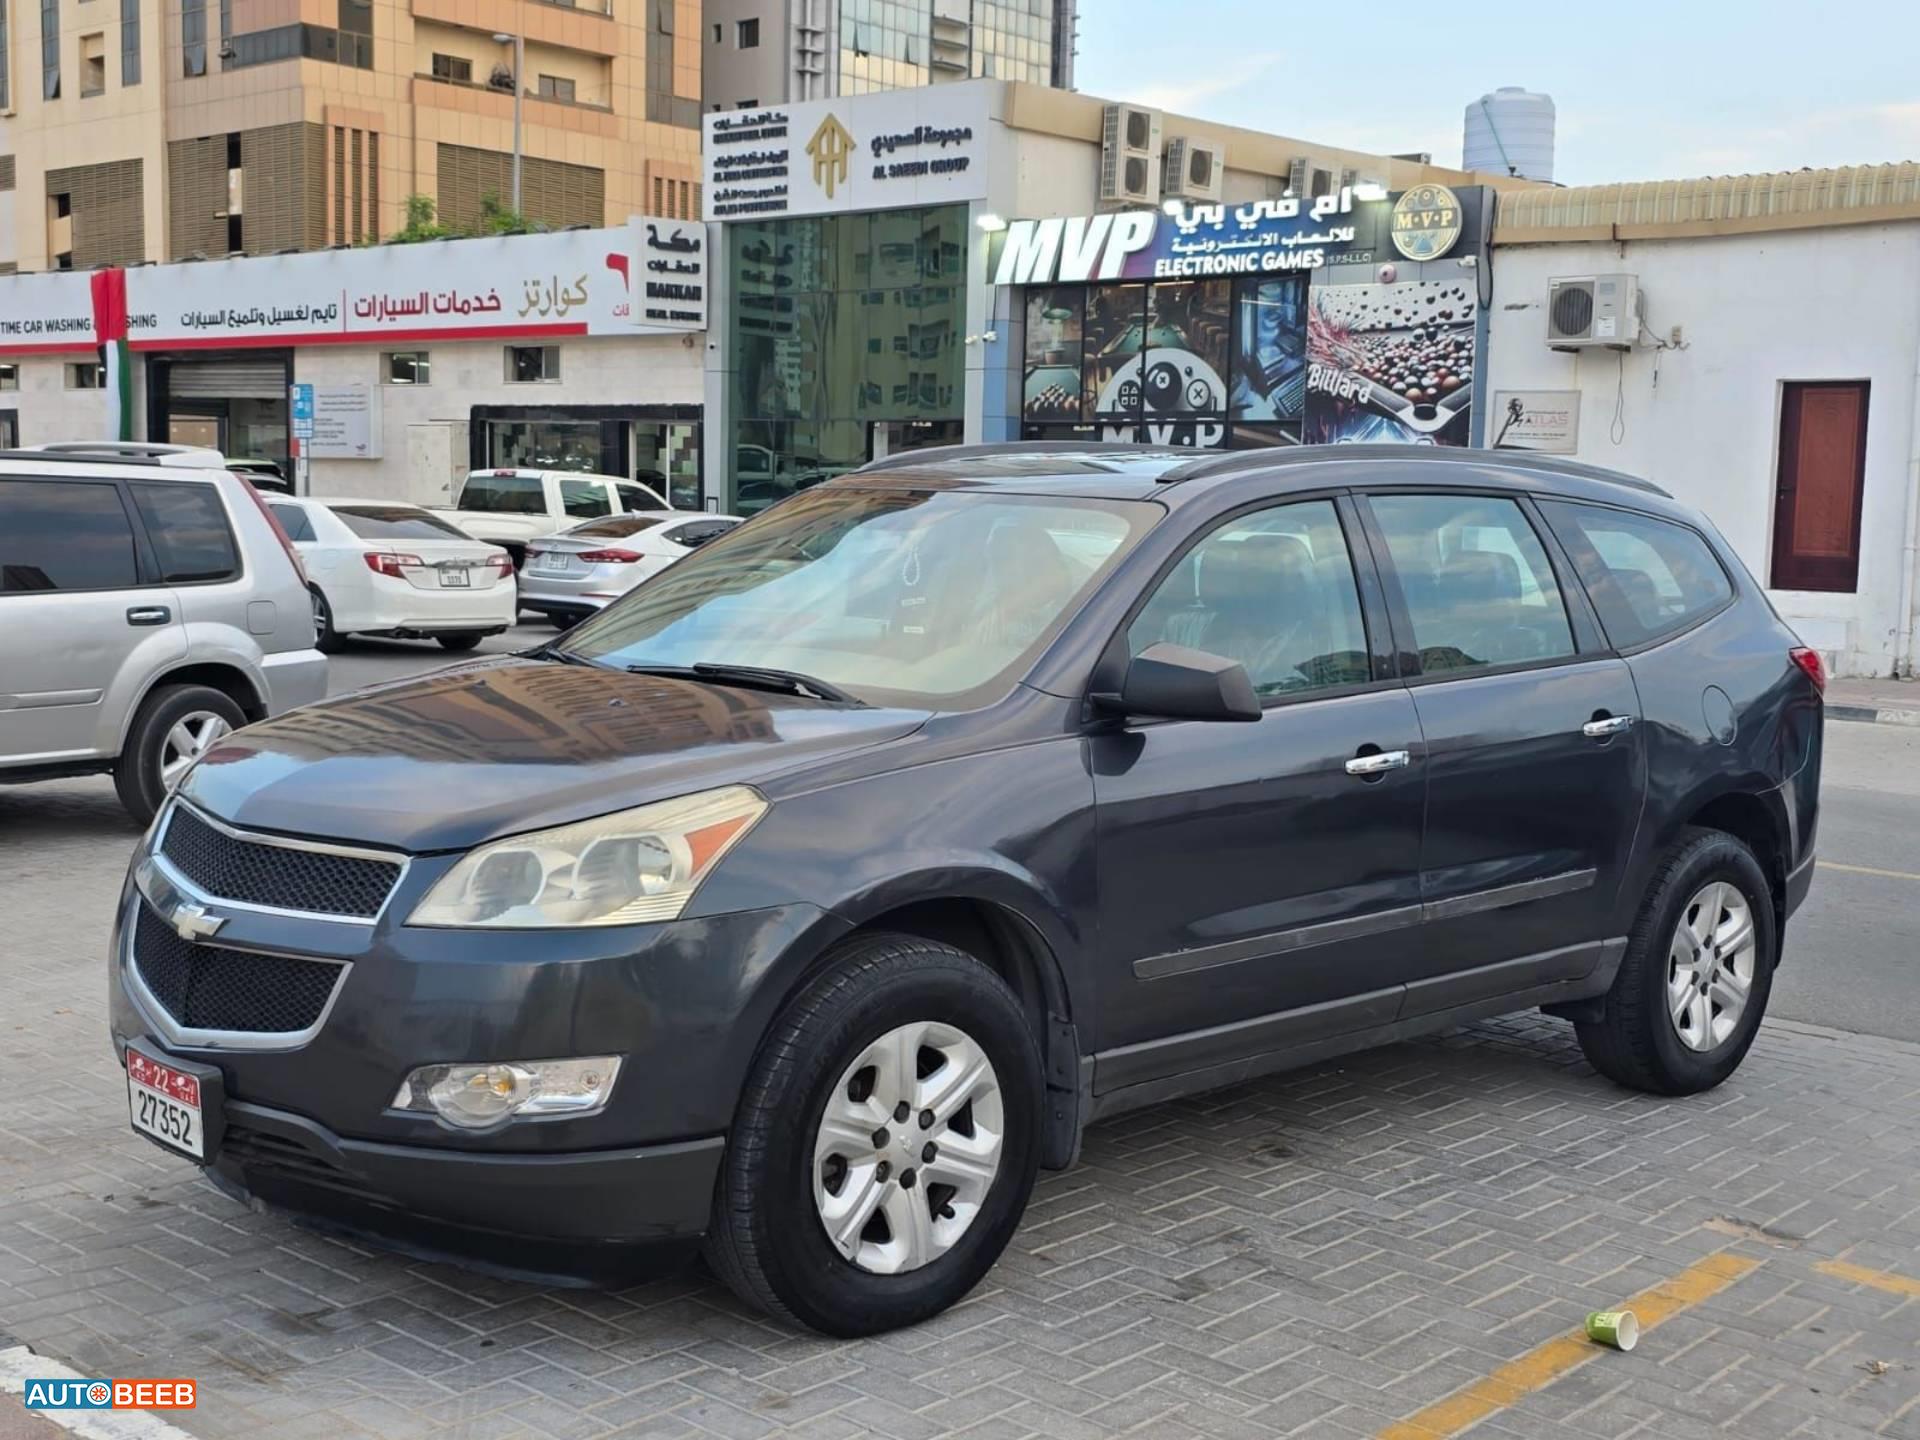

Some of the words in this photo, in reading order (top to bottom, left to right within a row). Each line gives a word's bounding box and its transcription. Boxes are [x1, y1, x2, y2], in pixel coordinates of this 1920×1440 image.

[872, 165, 887, 180] AL
[930, 157, 970, 174] GROUP
[646, 224, 701, 253] مكة
[995, 210, 1157, 285] MVP
[1155, 252, 1258, 278] ELECTRONIC
[1261, 248, 1324, 272] GAMES
[354, 292, 429, 322] السيارات
[433, 288, 502, 315] خدمات
[518, 275, 588, 317] كوارتز
[0, 321, 22, 335] TIME
[23, 320, 43, 334] CAR
[45, 317, 91, 333] WASHING
[125, 314, 158, 329] SHING
[180, 310, 226, 329] السيارات
[227, 308, 265, 328] وتلميع
[266, 304, 309, 326] لغسيل
[311, 303, 337, 324] تايم
[152, 1064, 170, 1094] 22
[138, 1089, 193, 1147] 27352
